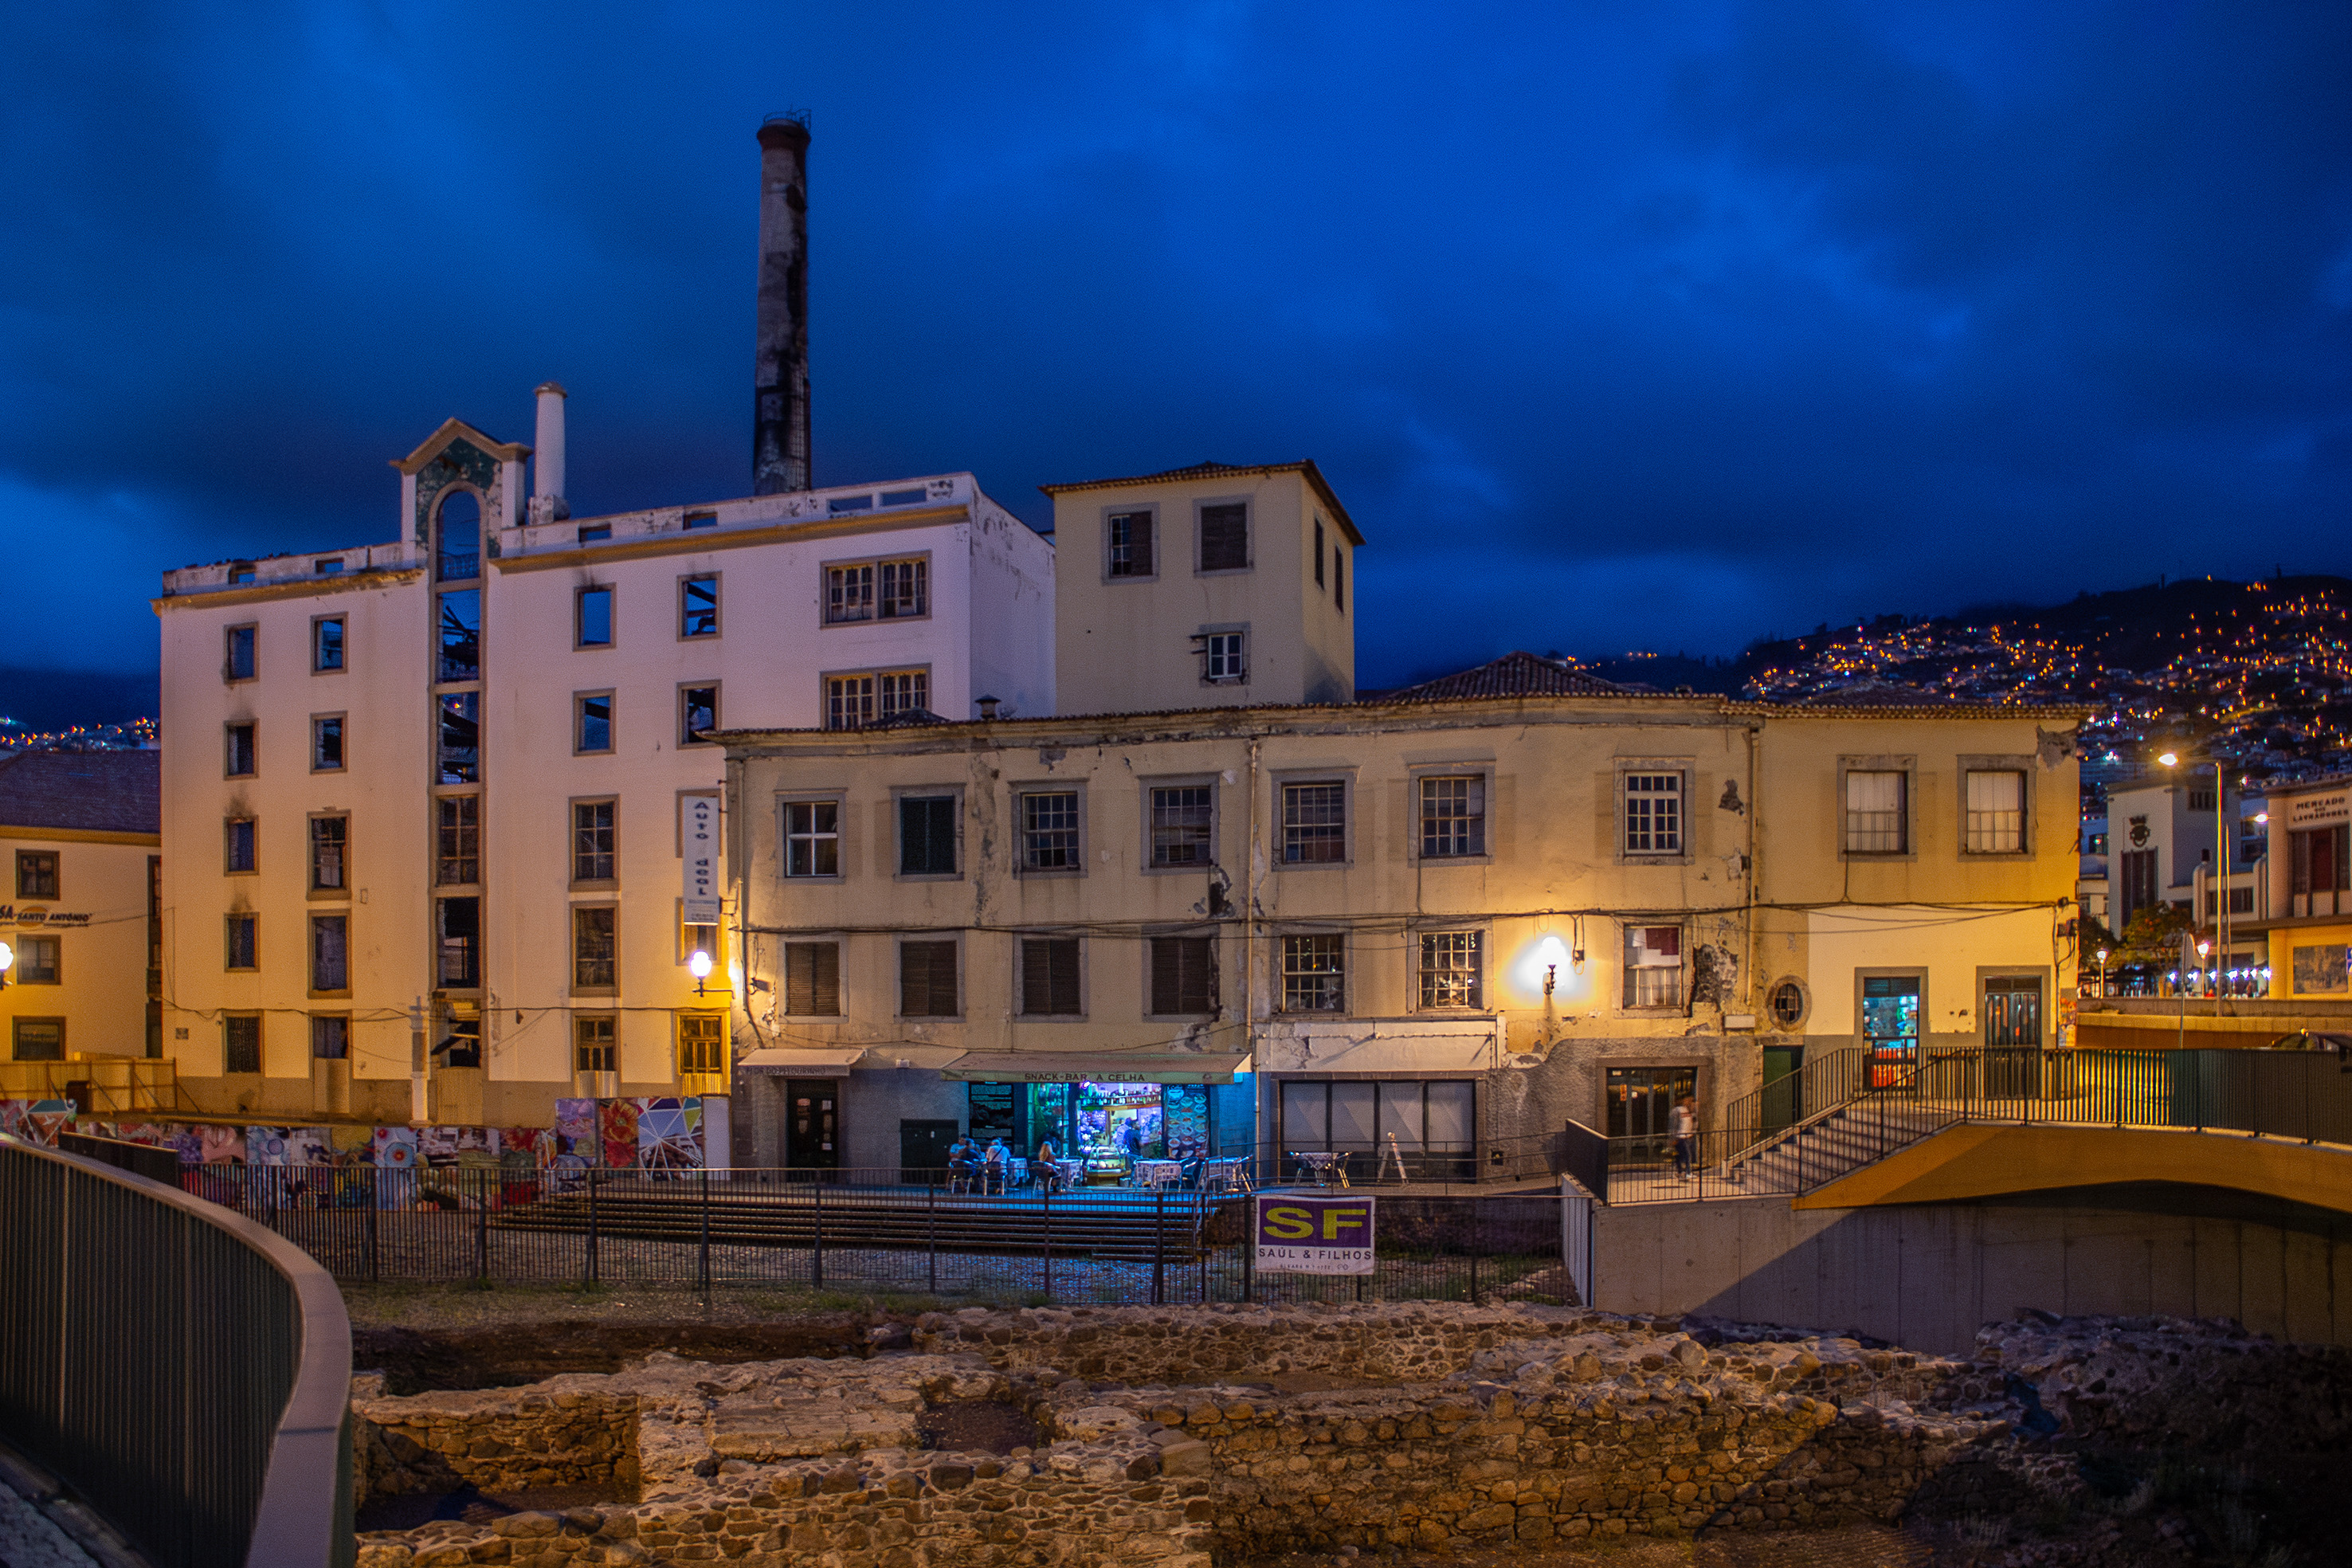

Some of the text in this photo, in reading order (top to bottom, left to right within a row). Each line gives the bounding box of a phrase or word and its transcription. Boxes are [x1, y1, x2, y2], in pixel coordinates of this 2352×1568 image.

[2296, 797, 2345, 809] MERCADO
[1025, 1072, 1088, 1081] SNACK-BAR
[1264, 1207, 1367, 1240] SF
[1259, 1247, 1371, 1260] SAÚL & FILHOS
